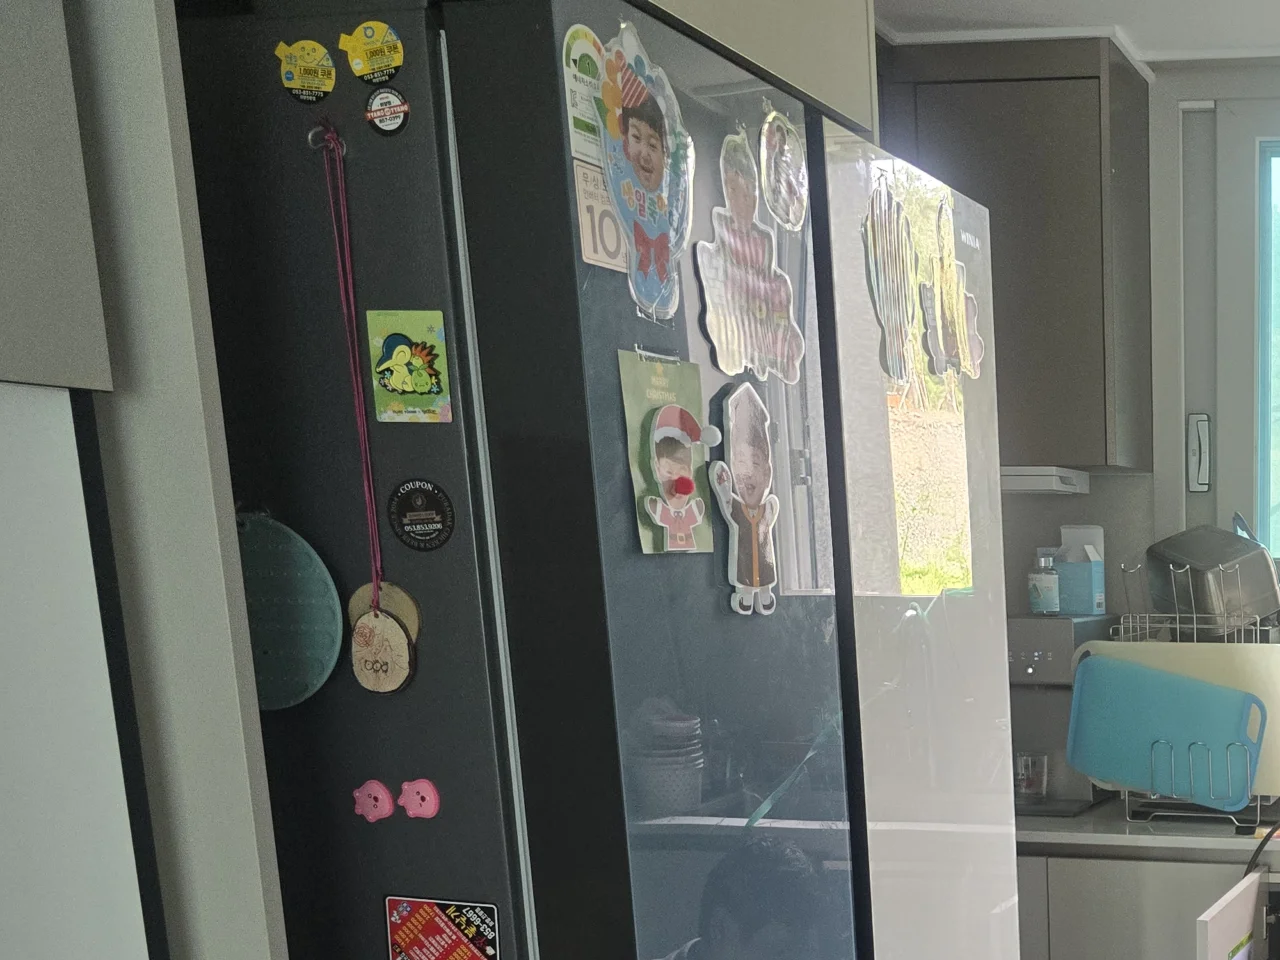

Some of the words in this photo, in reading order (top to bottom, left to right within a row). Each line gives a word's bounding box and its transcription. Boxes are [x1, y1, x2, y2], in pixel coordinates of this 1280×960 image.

[586, 204, 622, 260] 10
[960, 228, 980, 250] WINIA
[400, 481, 434, 493] COUPON
[445, 905, 477, 938] 불날개
[462, 907, 495, 939] 853-6667
